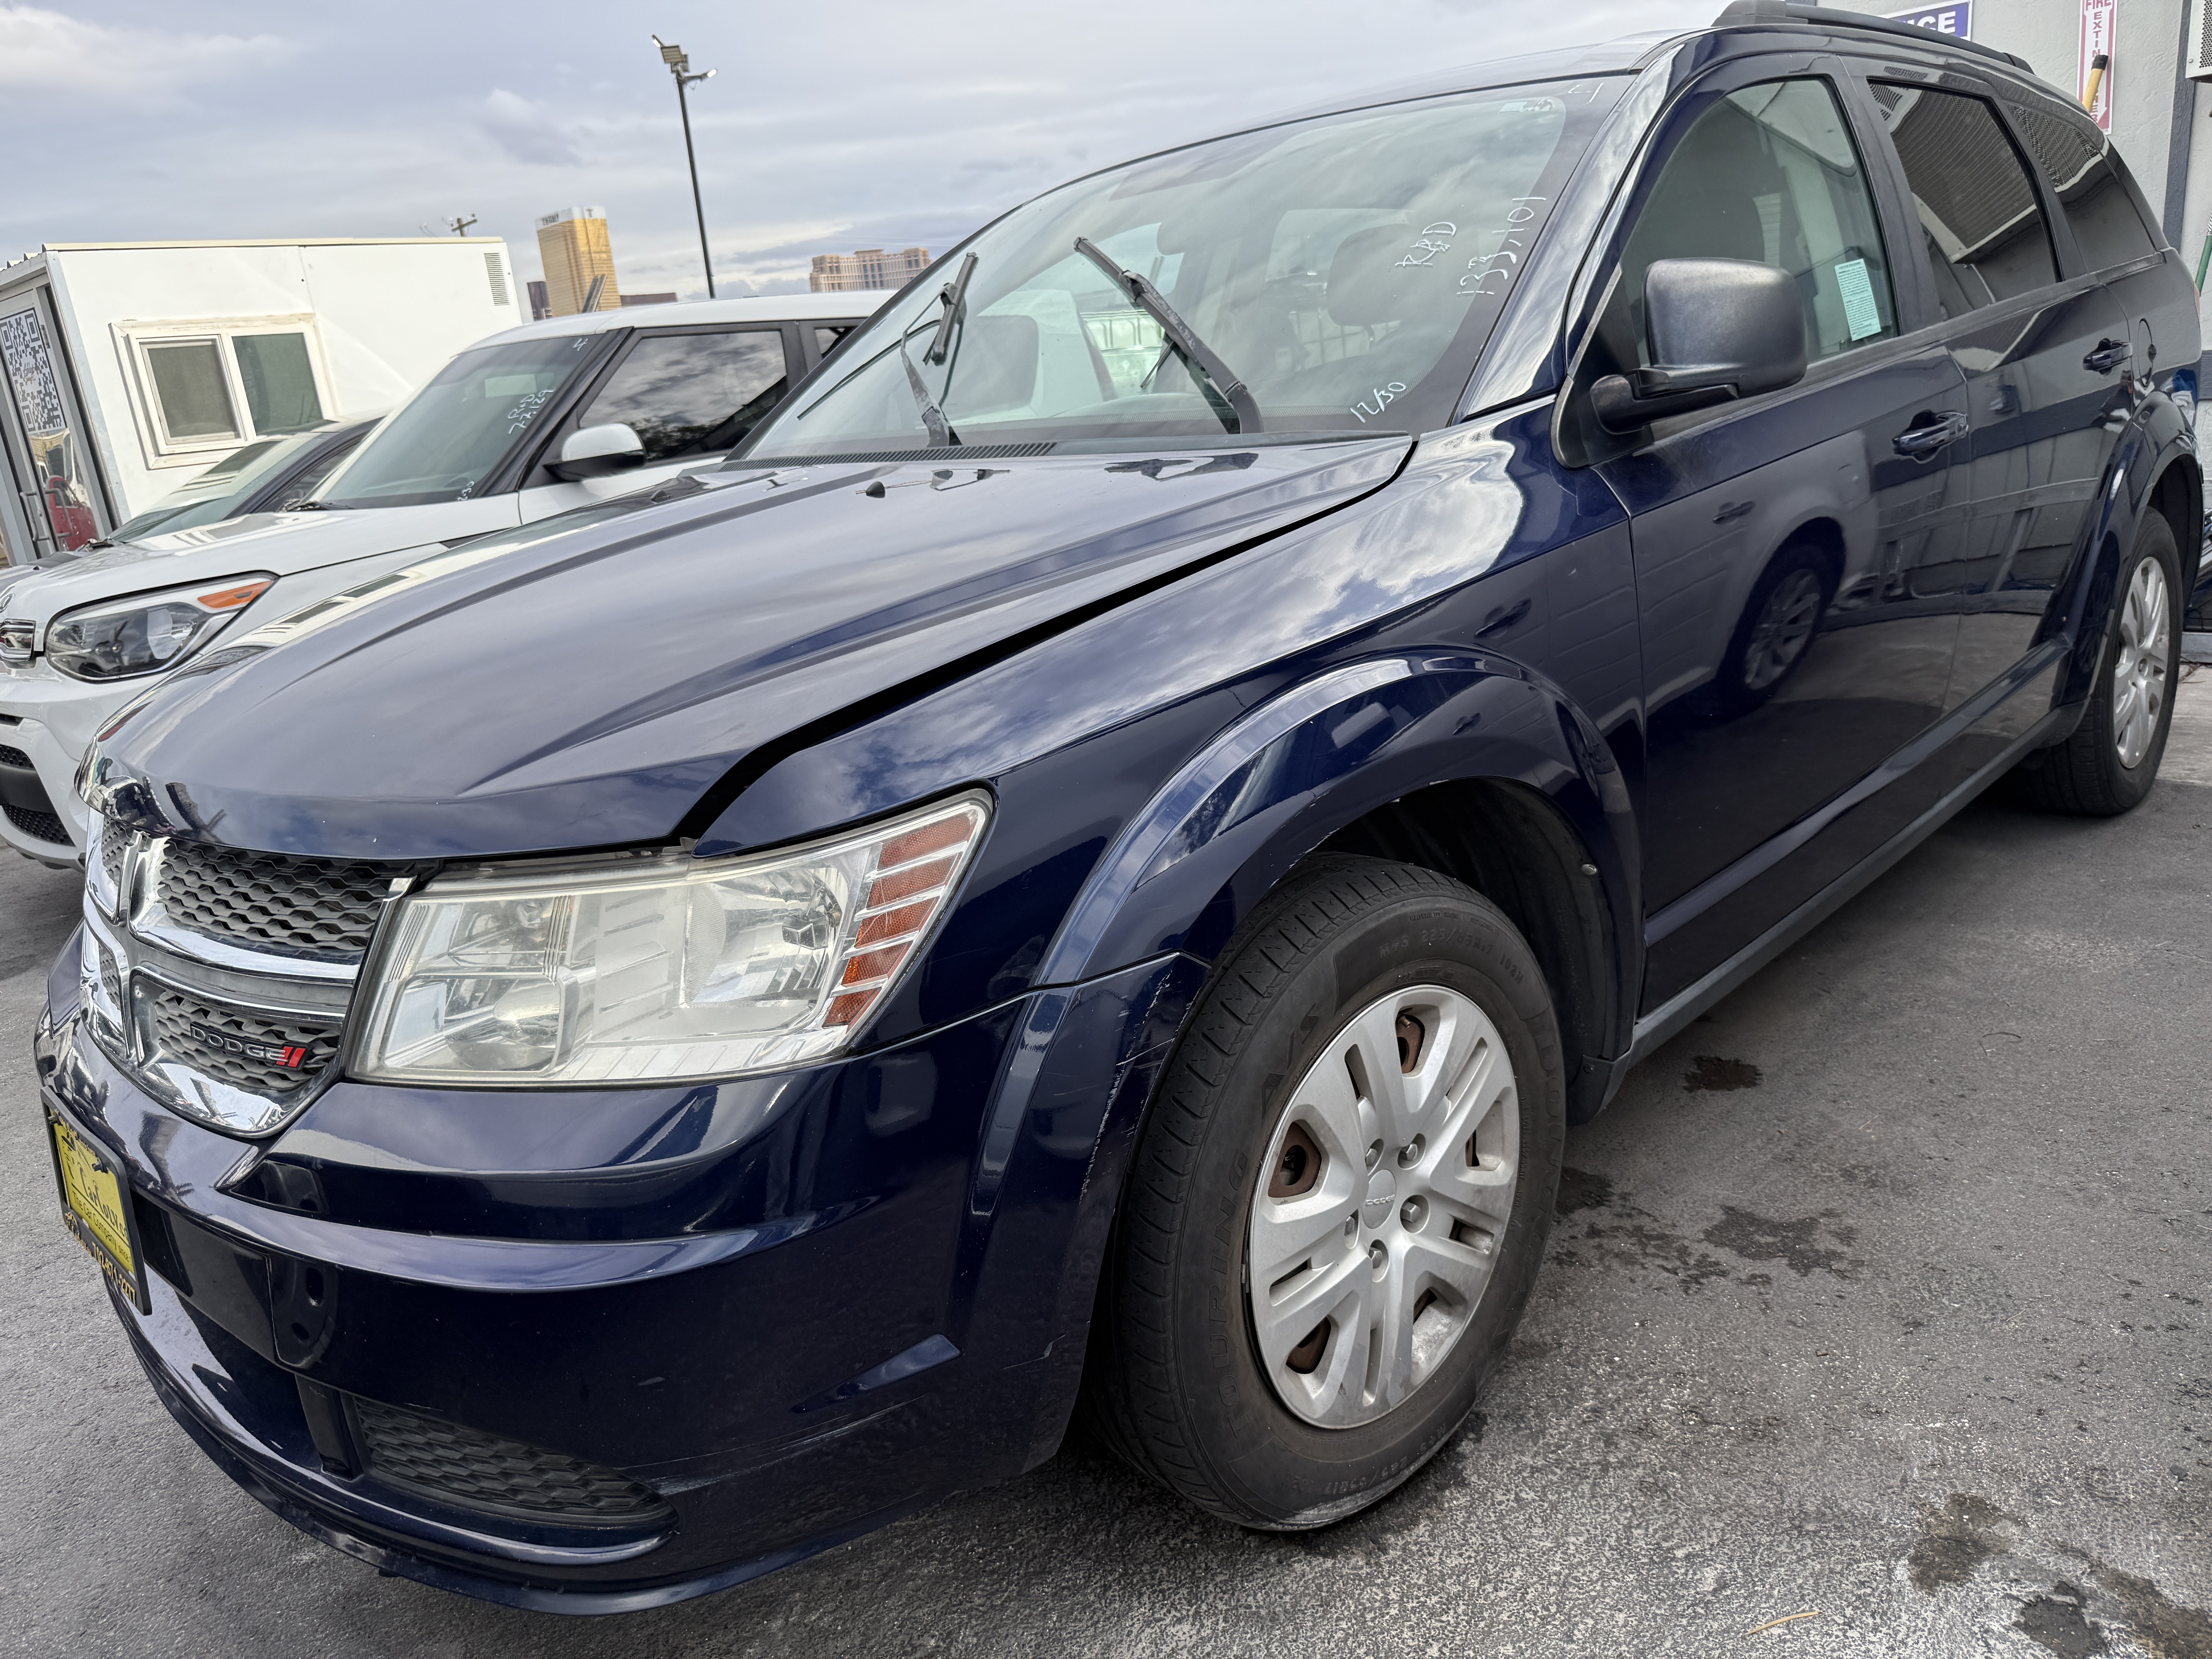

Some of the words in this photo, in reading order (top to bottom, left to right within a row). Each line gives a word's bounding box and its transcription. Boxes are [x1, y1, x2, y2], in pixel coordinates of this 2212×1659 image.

[191, 1026, 289, 1062] DODGE
[72, 1190, 83, 1211] The
[83, 1202, 92, 1220] Car
[93, 1213, 117, 1251] Company
[1209, 1147, 1250, 1439] TOURING
[1261, 1003, 1319, 1120] A/S
[1365, 1194, 1395, 1206] DODGE
[92, 1242, 136, 1306] 702-871-2277
